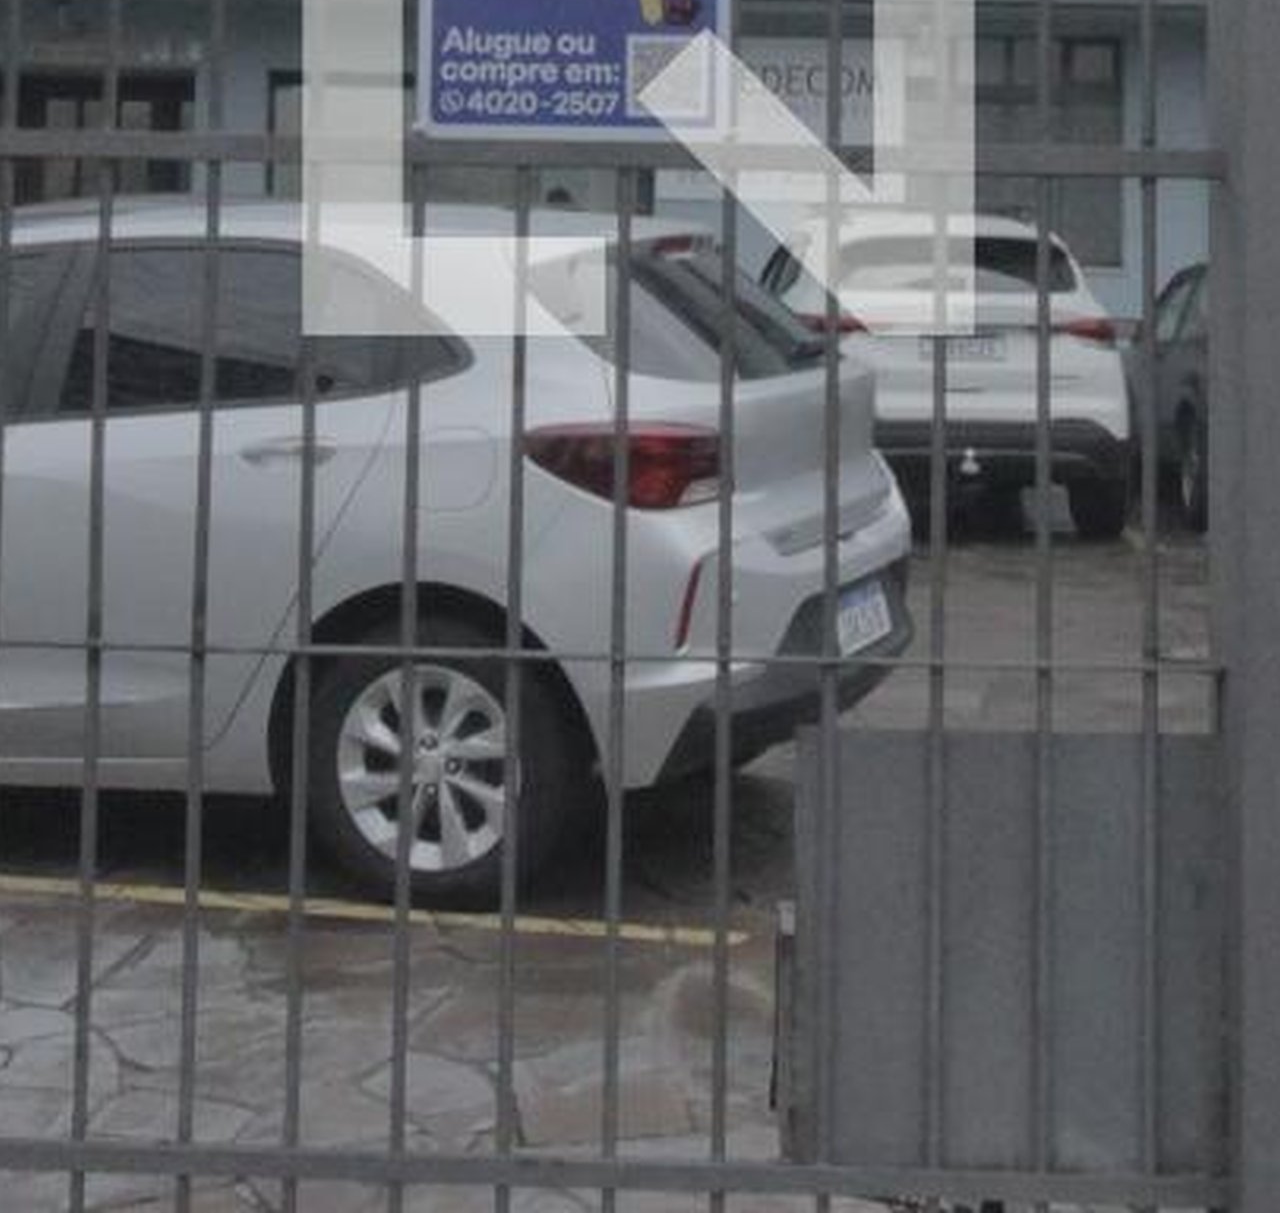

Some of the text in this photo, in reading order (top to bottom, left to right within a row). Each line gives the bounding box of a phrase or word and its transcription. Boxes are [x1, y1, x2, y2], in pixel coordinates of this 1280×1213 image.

[440, 26, 596, 58] Alugue ou
[439, 58, 621, 86] compre em:
[466, 90, 620, 116] 4020-2507
